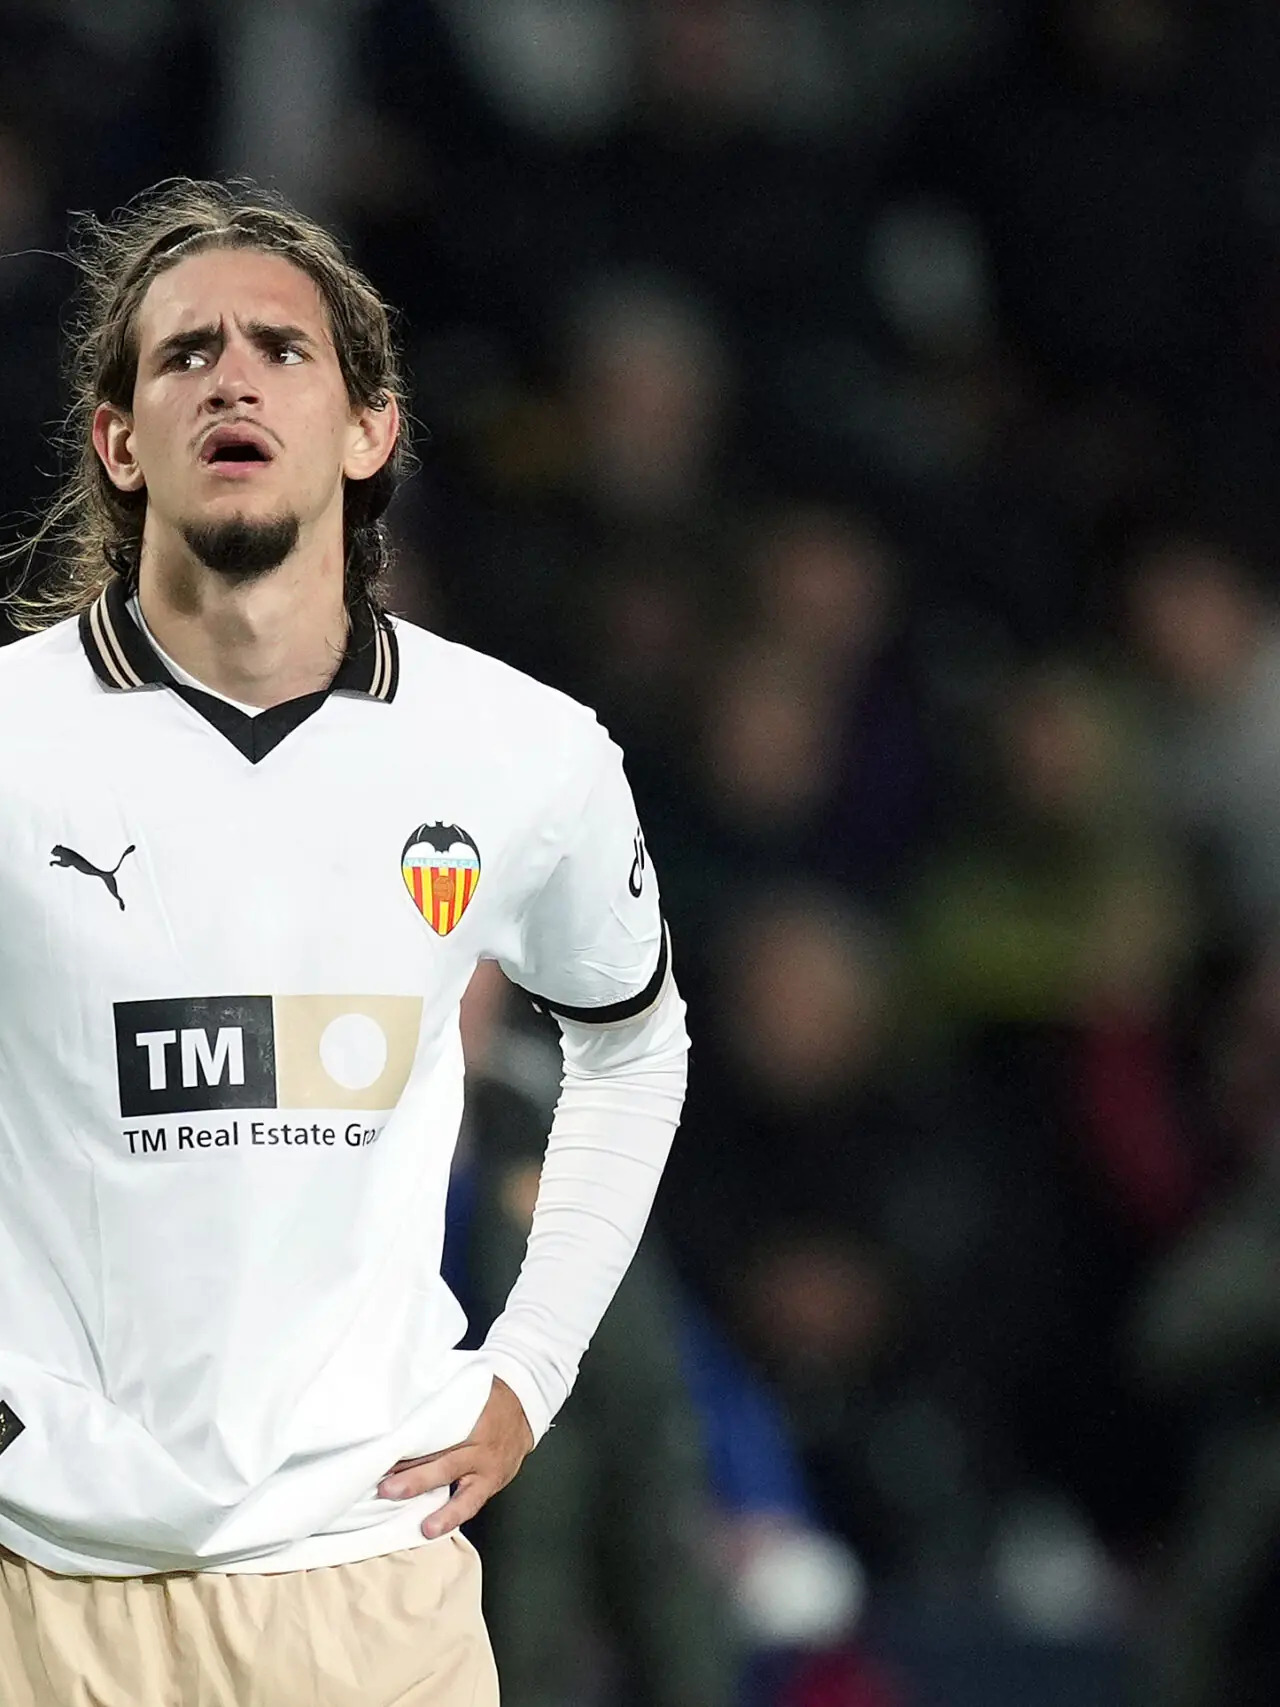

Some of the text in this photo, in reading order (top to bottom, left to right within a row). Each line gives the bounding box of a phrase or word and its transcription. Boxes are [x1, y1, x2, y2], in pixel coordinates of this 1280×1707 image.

[135, 1026, 245, 1091] TM
[122, 1127, 167, 1154] TM
[177, 1121, 239, 1150] Real
[250, 1122, 336, 1146] Estate
